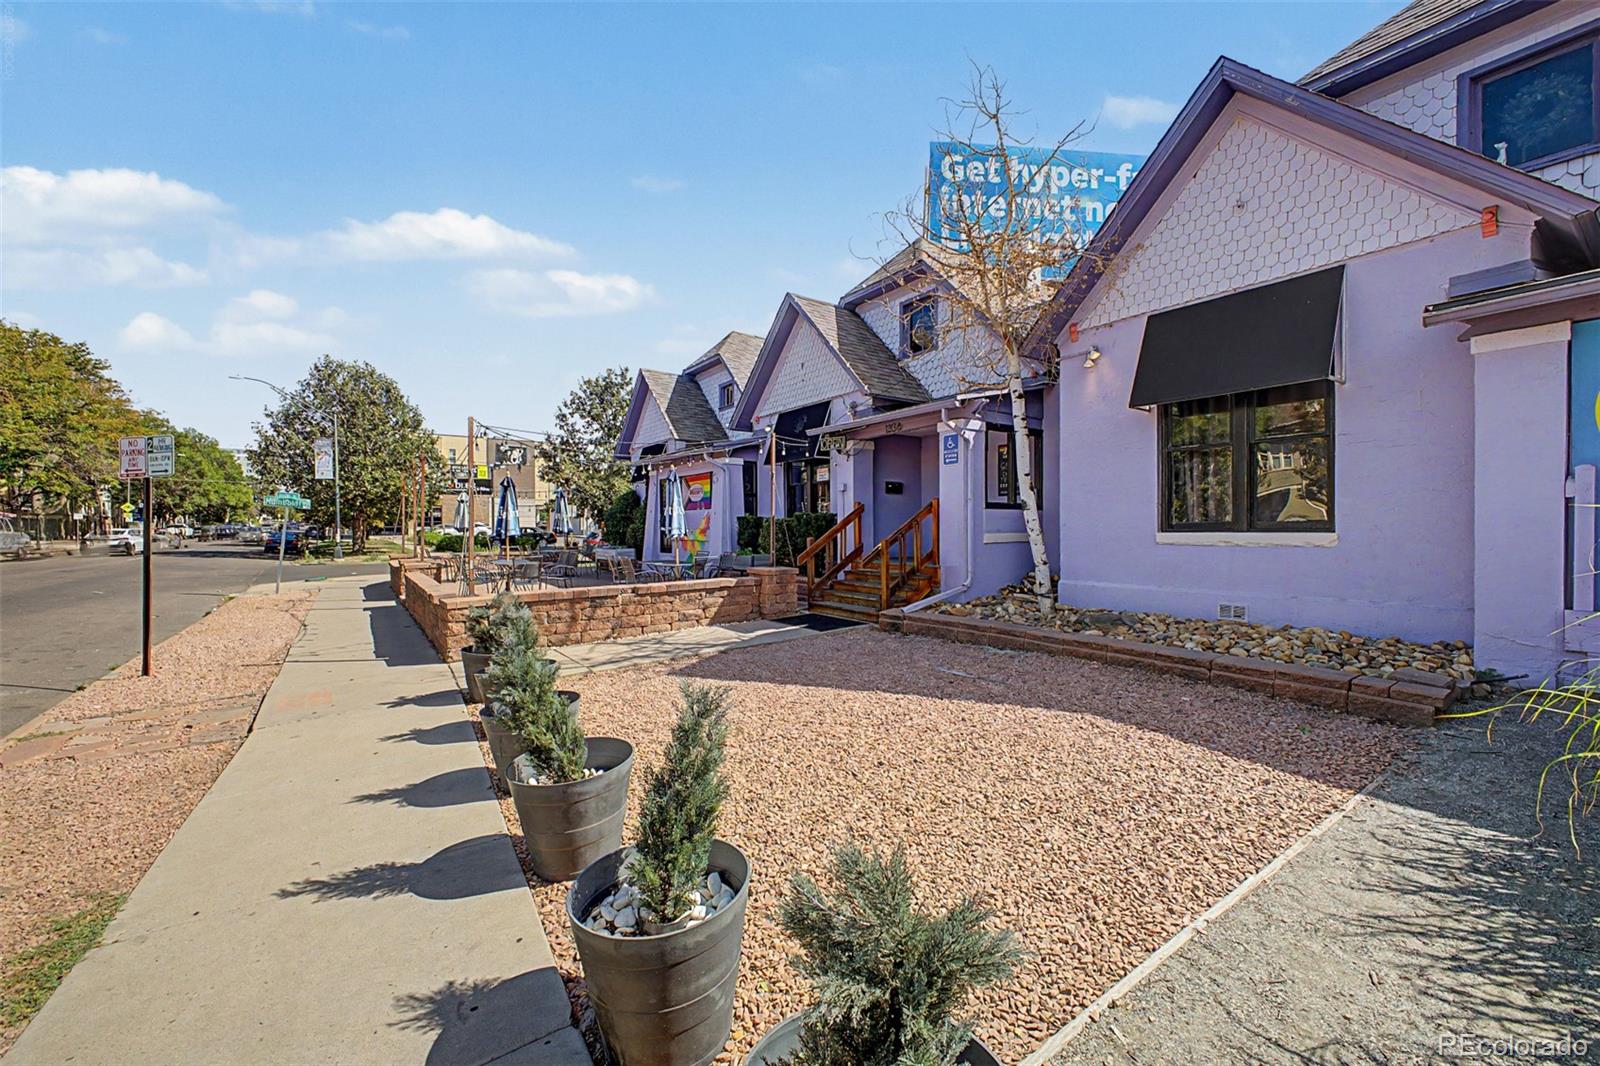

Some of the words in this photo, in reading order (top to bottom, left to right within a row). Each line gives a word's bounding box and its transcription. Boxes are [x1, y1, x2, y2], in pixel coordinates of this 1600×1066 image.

[941, 154, 1001, 183] Get
[1008, 156, 1138, 196] hyper-f
[127, 439, 139, 448] NO
[147, 439, 154, 451] 2
[121, 447, 145, 457] PARKING
